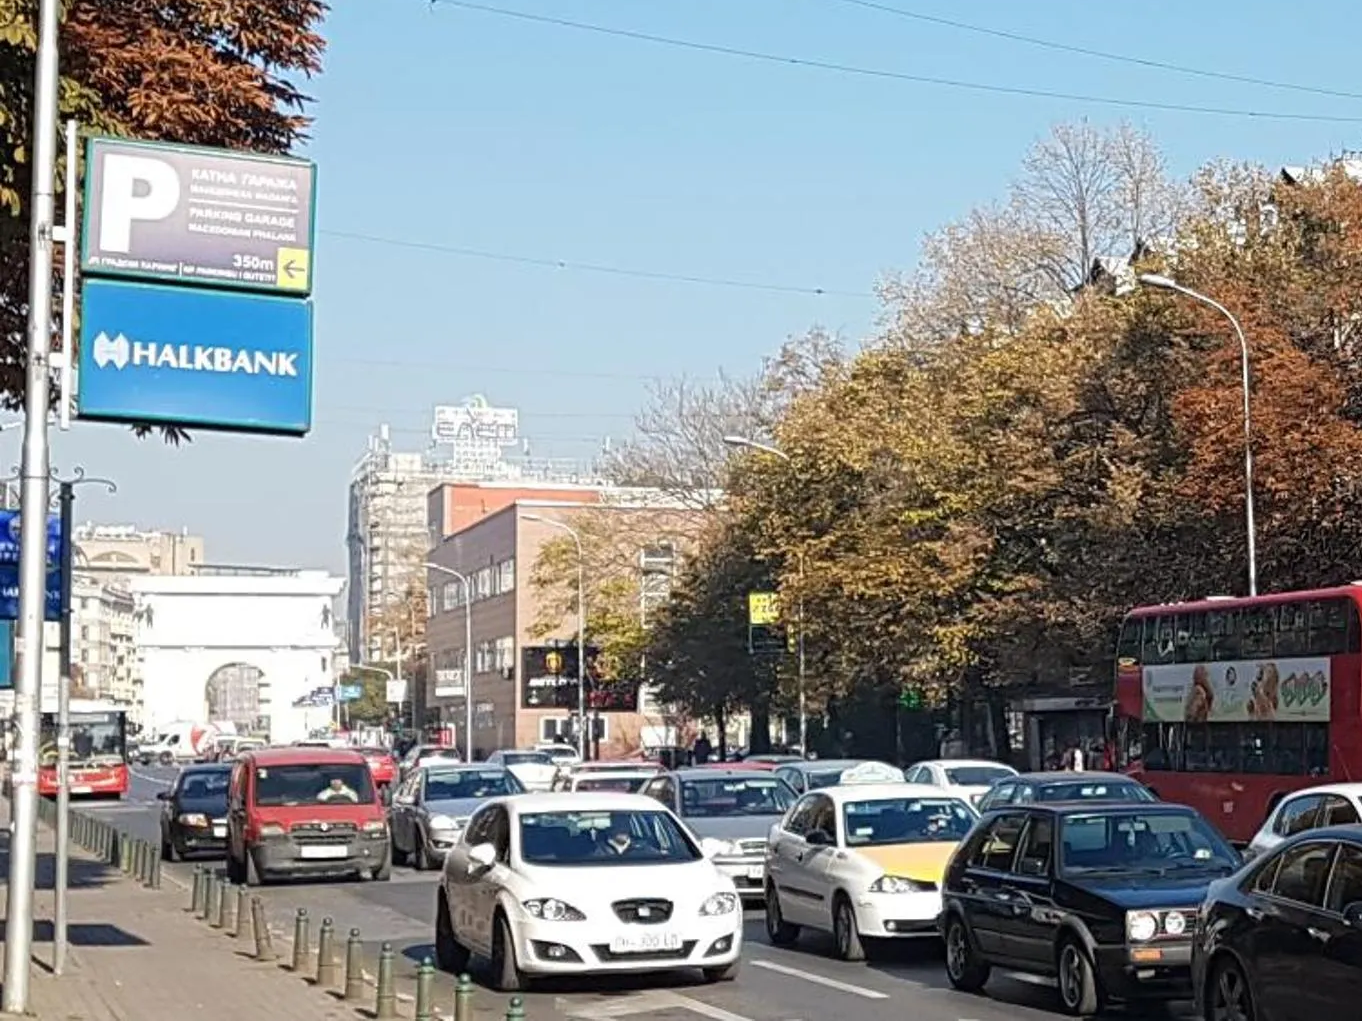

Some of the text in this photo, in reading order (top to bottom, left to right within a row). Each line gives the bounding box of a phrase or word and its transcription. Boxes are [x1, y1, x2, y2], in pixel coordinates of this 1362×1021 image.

[100, 154, 180, 252] P
[233, 254, 274, 271] 350m
[133, 341, 298, 376] HALKBANK
